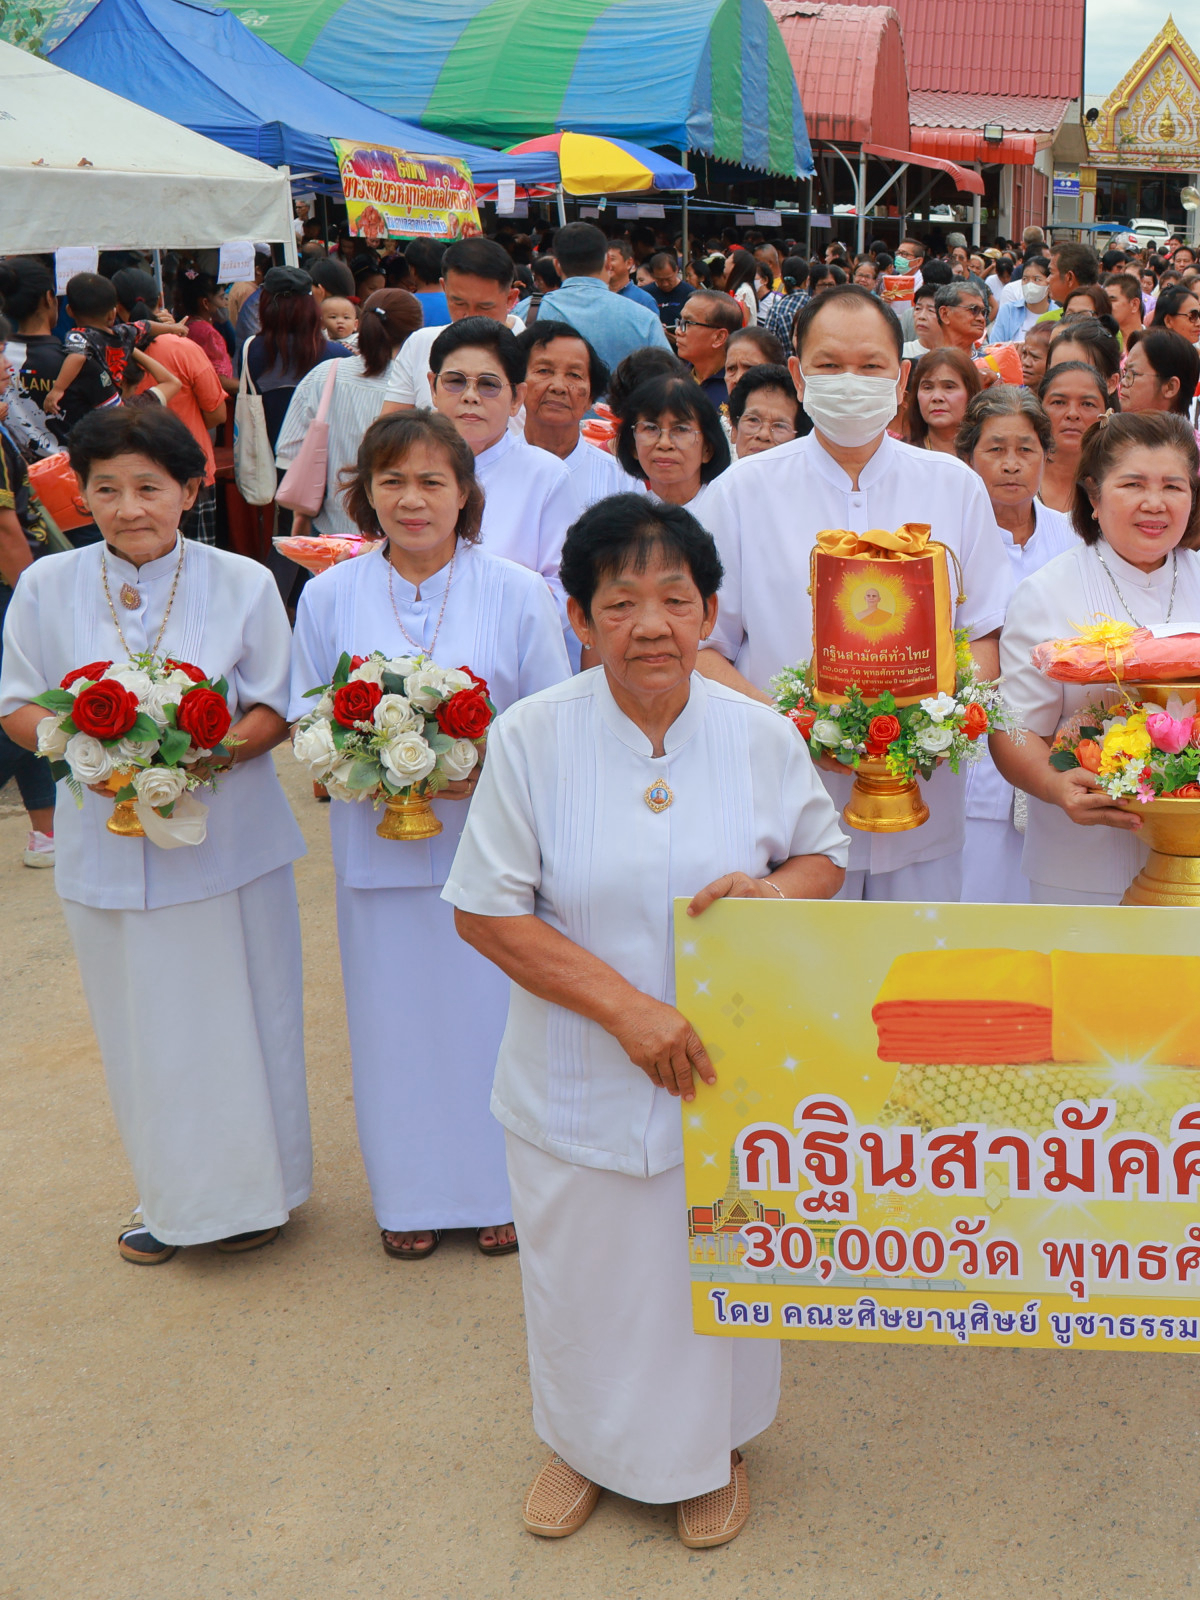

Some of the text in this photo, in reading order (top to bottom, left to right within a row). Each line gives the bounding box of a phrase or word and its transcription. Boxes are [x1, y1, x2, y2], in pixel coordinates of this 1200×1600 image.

[822, 645, 930, 662] กฐินสามัคคีทั่วไทย
[745, 1221, 1019, 1278] 30,000วัด
[711, 1291, 769, 1323] โดย
[783, 1299, 1038, 1340] คณะศิษยานุศิษย์
[1052, 1315, 1197, 1344] บูชาธรรม
